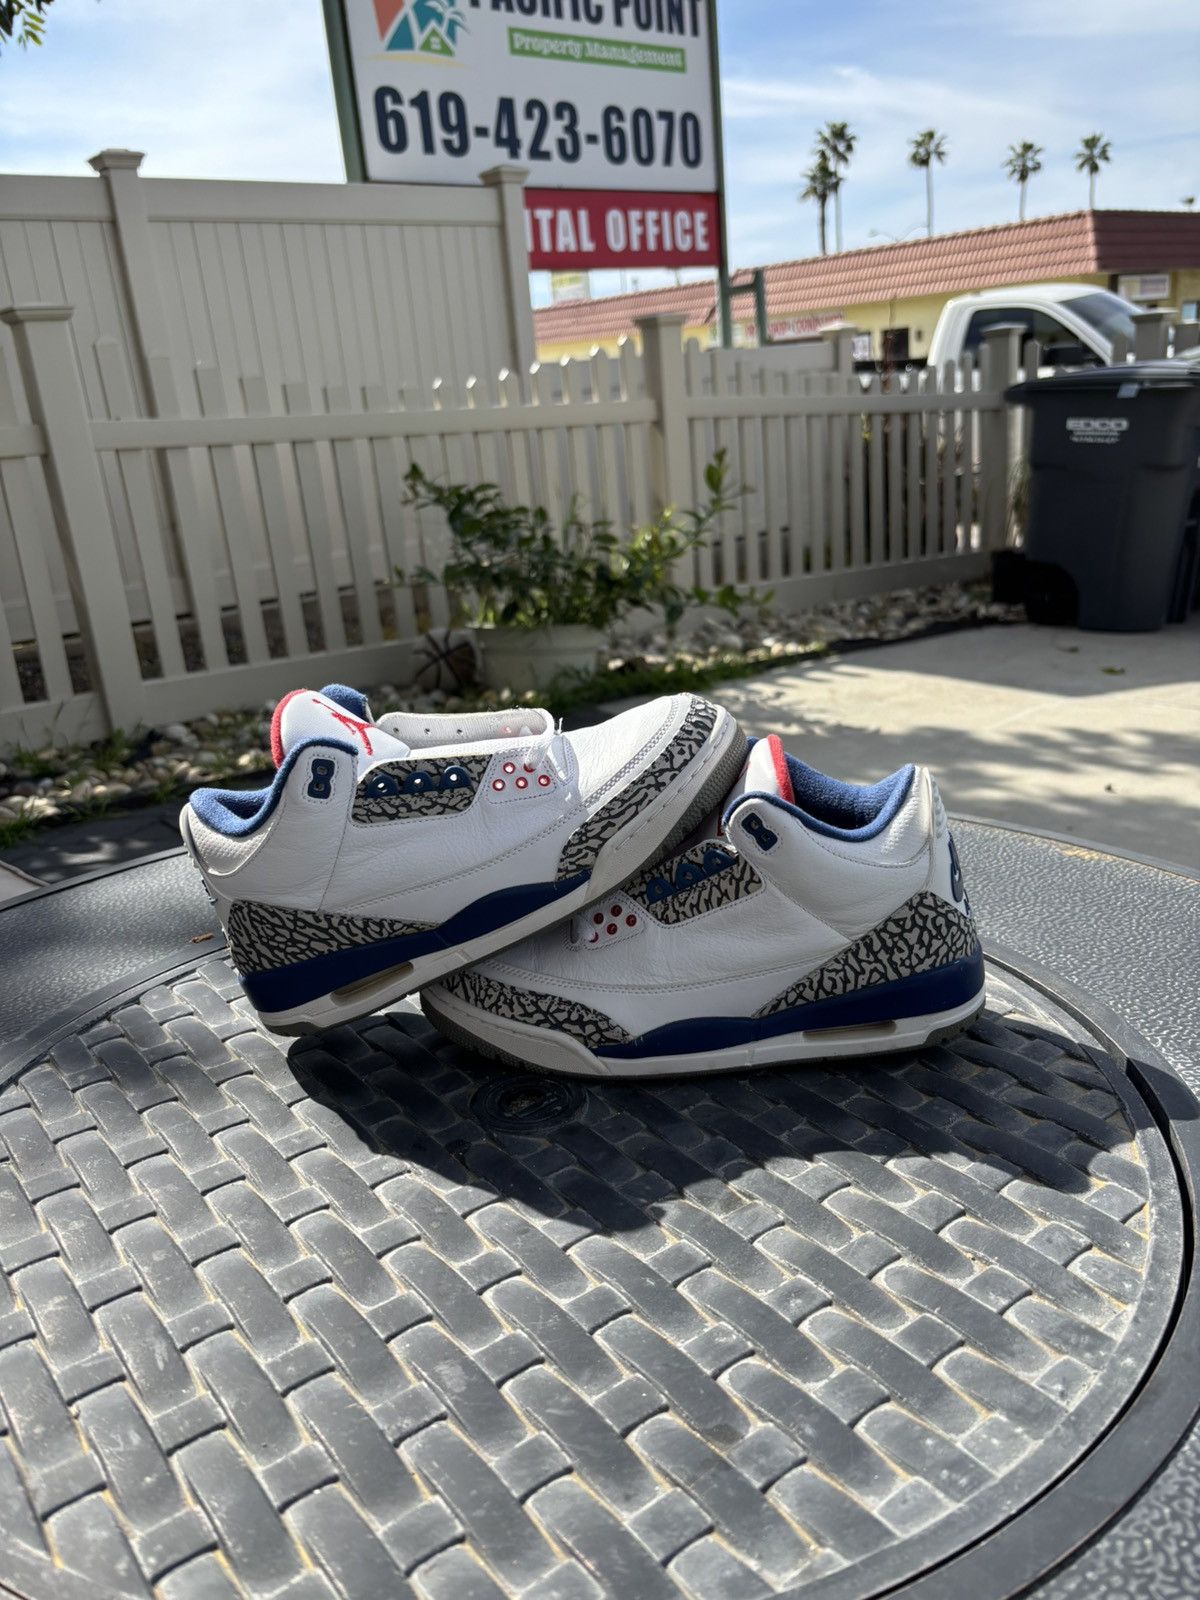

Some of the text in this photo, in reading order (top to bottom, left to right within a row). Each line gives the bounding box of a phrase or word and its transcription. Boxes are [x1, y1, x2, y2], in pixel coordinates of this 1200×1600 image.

[512, 32, 684, 67] Property Management
[374, 86, 703, 169] 619-423-6070
[605, 208, 709, 252] OFFICE
